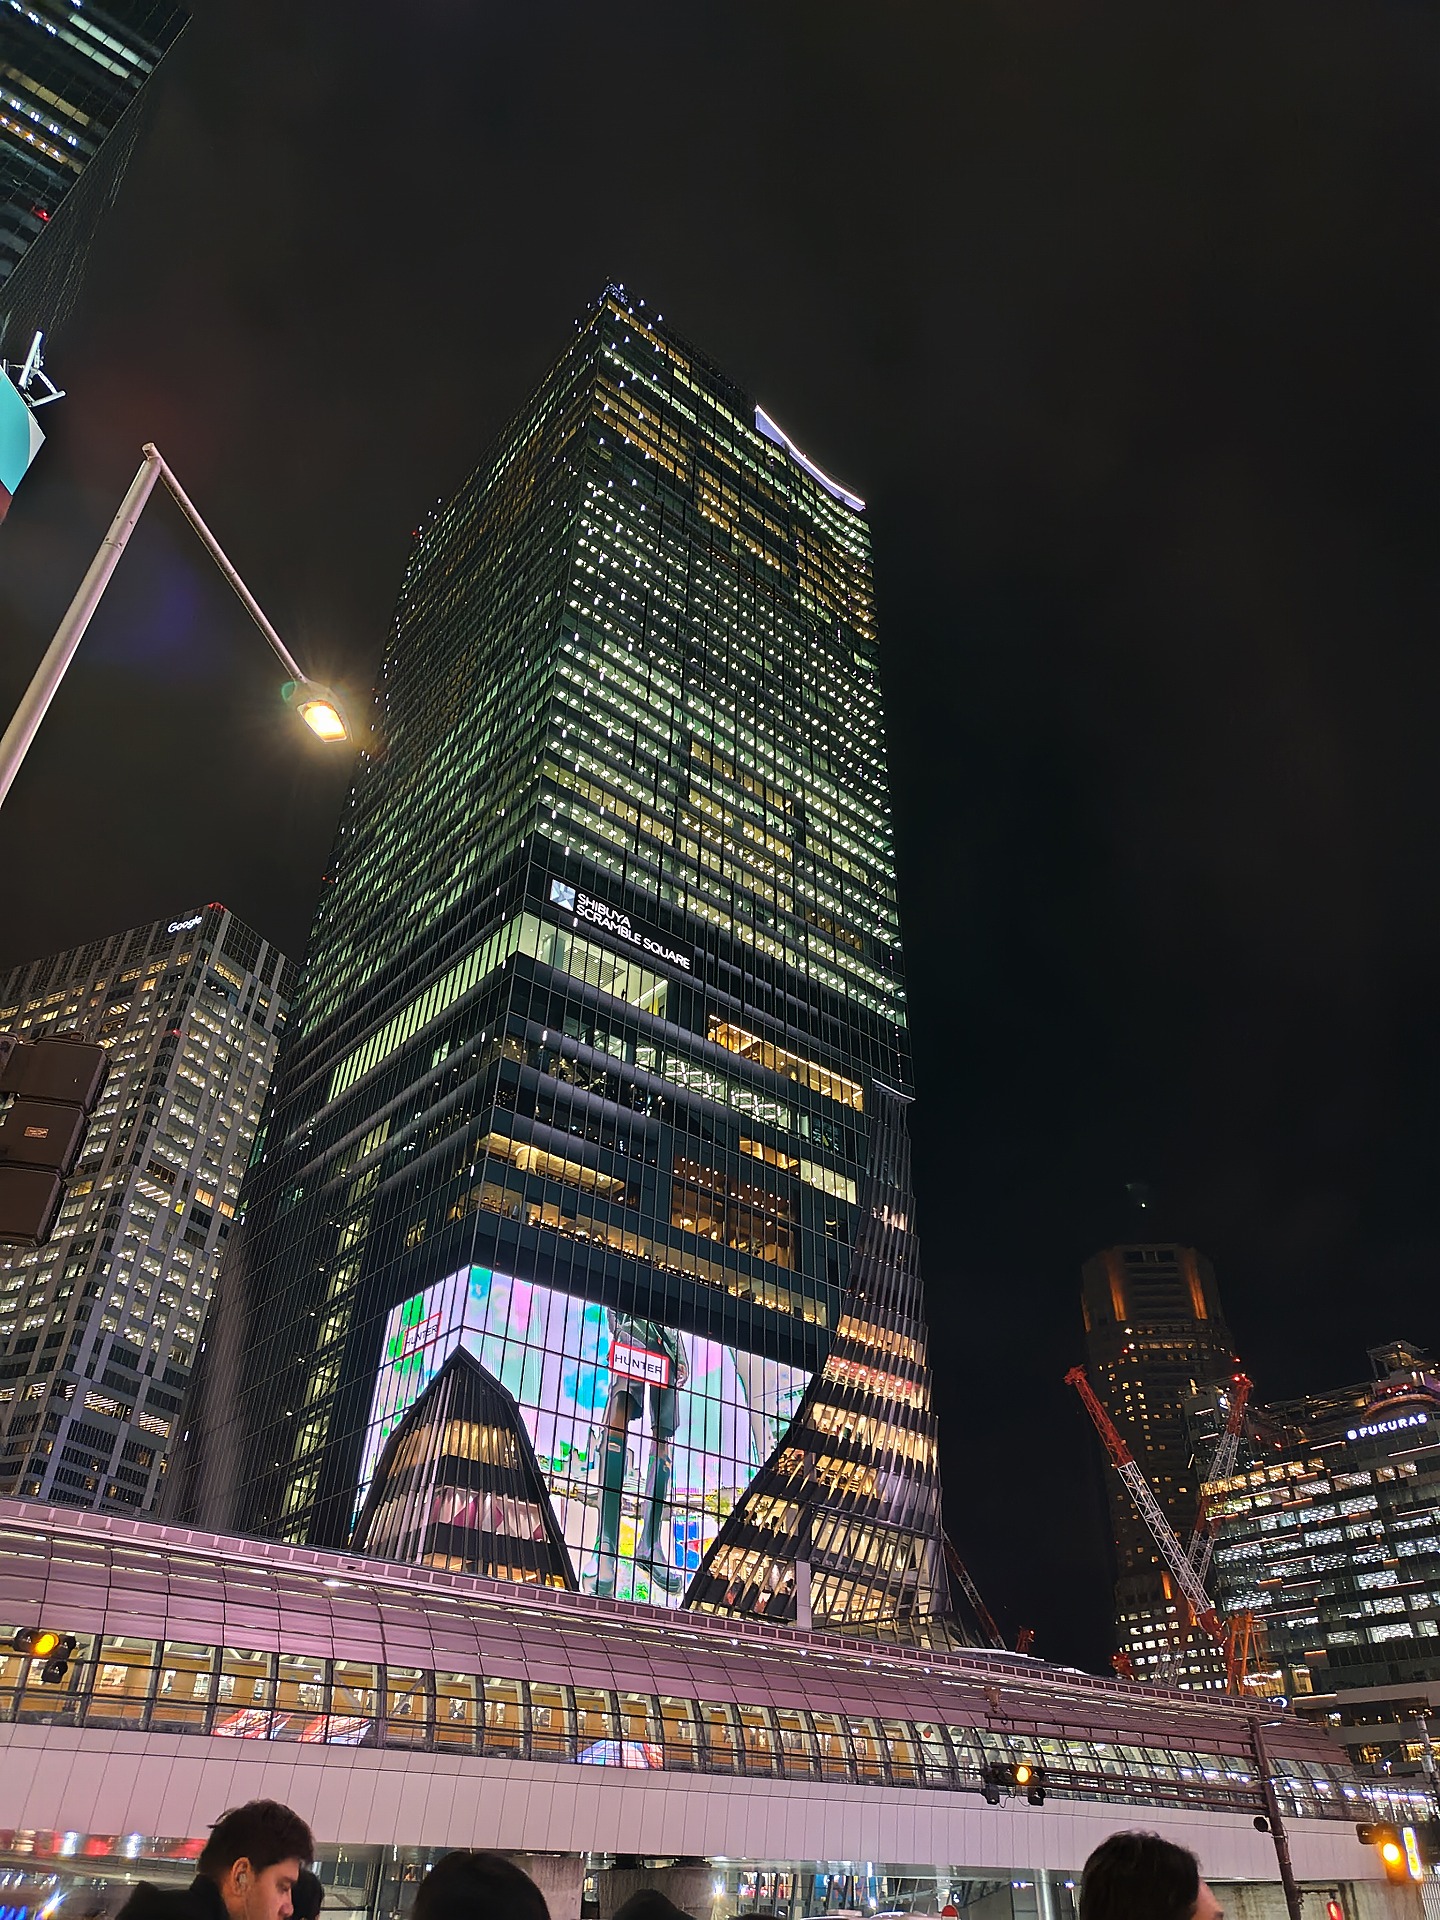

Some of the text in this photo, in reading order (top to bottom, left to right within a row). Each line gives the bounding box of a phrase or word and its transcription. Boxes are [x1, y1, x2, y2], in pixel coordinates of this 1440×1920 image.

[577, 893, 631, 928] SHIBUYA
[168, 915, 202, 933] Google
[576, 905, 690, 970] SCRAMBLE SQUARE
[615, 1354, 662, 1376] HUNTER
[1359, 1413, 1427, 1438] FUKURAS
